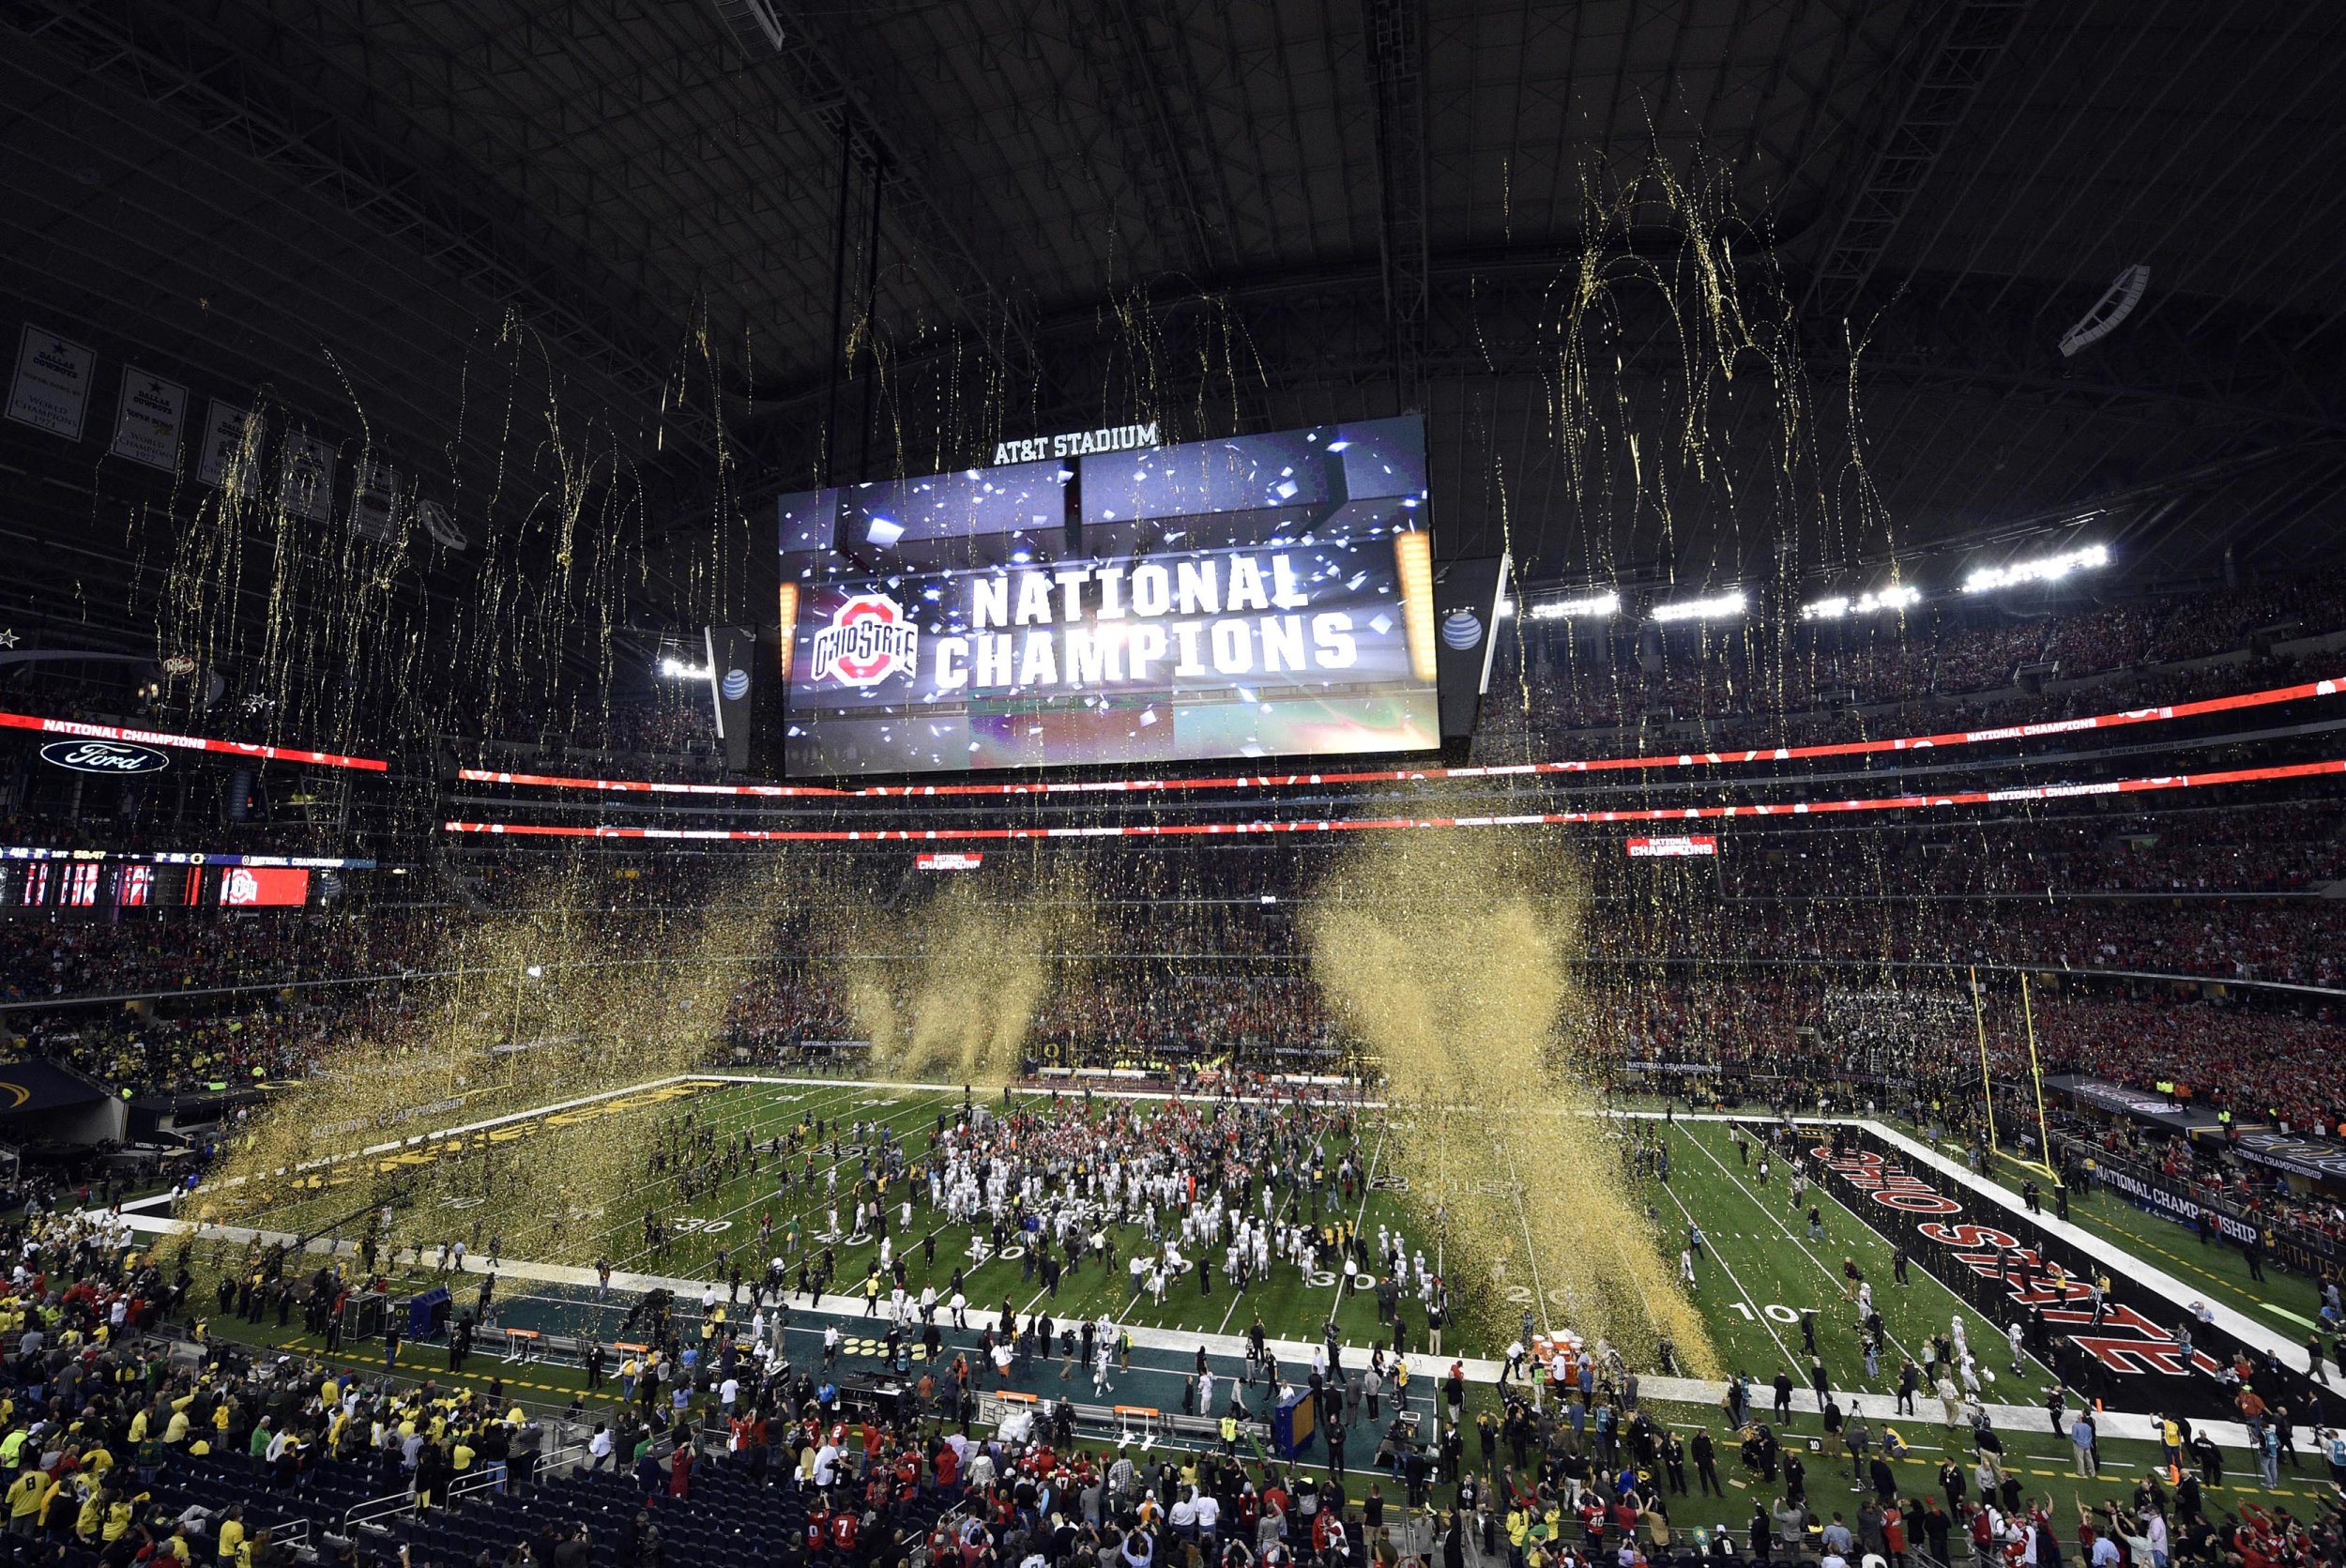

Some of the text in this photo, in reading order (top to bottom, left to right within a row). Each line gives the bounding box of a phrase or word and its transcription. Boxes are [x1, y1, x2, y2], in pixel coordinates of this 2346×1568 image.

[34, 357, 78, 379] COWBOYS
[39, 351, 75, 370] DALLAS
[29, 395, 68, 414] WORLD
[133, 396, 173, 415] COWBOYS
[139, 390, 170, 406] DALLAS
[15, 400, 78, 427] CHAMPIONS
[131, 431, 164, 449] WORLD
[994, 422, 1158, 465] AT&T STADIUM
[972, 555, 1308, 628] NATIONAL
[815, 620, 916, 677] OHIO STATE
[935, 612, 1357, 690] CHAMPIONS
[42, 720, 206, 750] NATIONAL CHAMPIONS
[1967, 718, 2096, 742] NATIONAL CHAMPIONS
[65, 743, 148, 769] Ford
[1988, 783, 2119, 801] NATIONAL CHAMPIONS
[1631, 845, 1713, 856] CHAMPIONS
[1649, 837, 1690, 846] NATIONAL
[919, 860, 981, 870] CHAMPIONS
[1626, 1061, 1664, 1070] NATIONAL
[2263, 1155, 2323, 1180] CHAMPIONSHIP
[1809, 1146, 1962, 1213] OHIO
[2095, 1164, 2152, 1200] NATIONAL
[1917, 1222, 2219, 1377] STATE
[1729, 1302, 1800, 1323] 10
[833, 1425, 843, 1438] 2
[1810, 1439, 1820, 1451] 10
[1055, 1476, 1070, 1491] 47
[838, 1519, 849, 1537] 7
